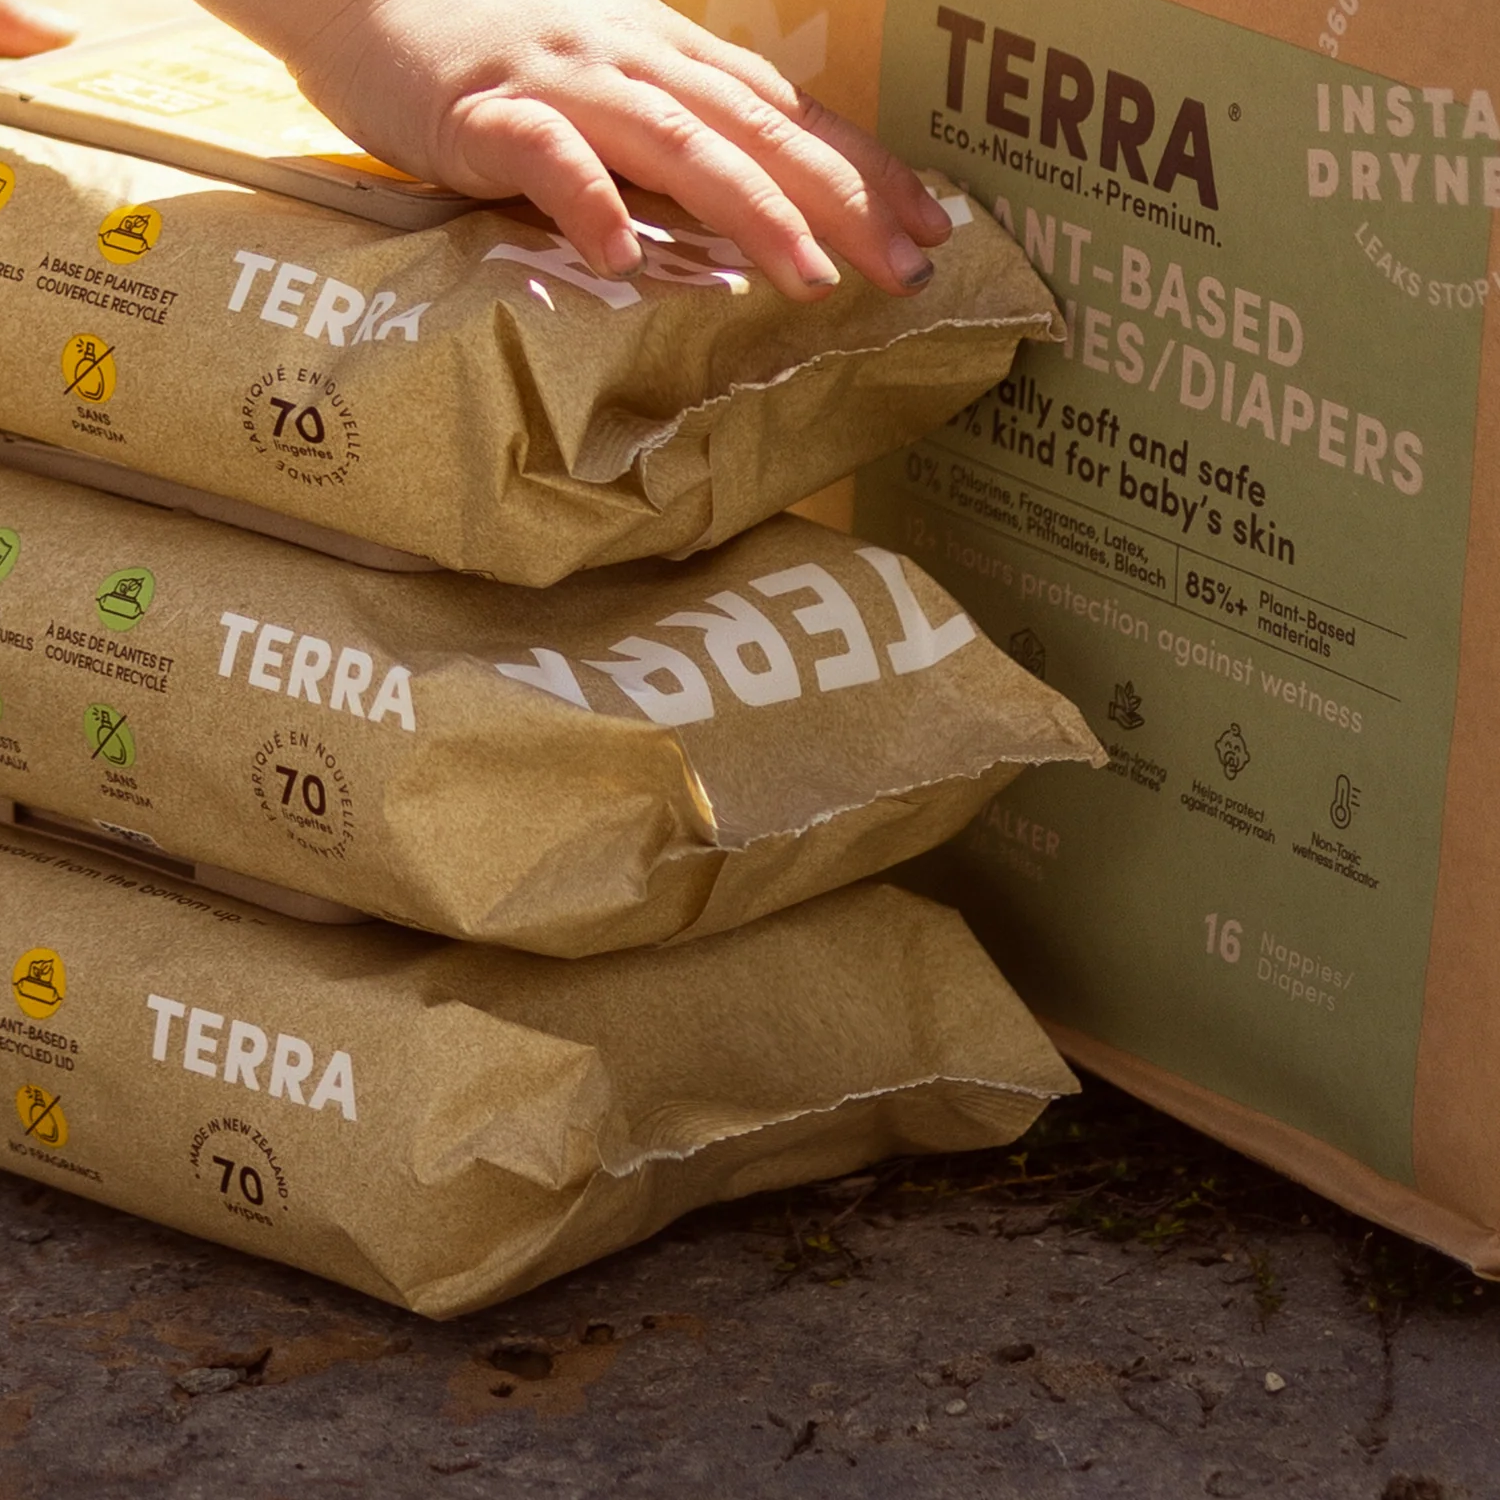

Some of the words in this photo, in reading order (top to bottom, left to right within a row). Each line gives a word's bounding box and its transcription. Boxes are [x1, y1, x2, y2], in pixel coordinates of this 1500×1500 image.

[937, 4, 1219, 212] TERRA
[39, 252, 50, 270] À
[51, 256, 83, 280] BASE
[85, 267, 103, 284] DE
[104, 273, 160, 301] PLANTES
[161, 289, 179, 306] ET
[1354, 220, 1421, 298] LEAKS
[1428, 278, 1489, 310] STOP
[36, 276, 110, 309] COUVERCLE
[112, 298, 169, 325] RECYCLÉ
[227, 249, 433, 347] TERRA
[297, 368, 322, 385] EN
[72, 420, 127, 444] PARFUM
[77, 407, 112, 426] SANS
[270, 397, 325, 444] 70
[273, 439, 334, 461] lingettes
[906, 452, 941, 492] 0%
[1061, 403, 1120, 448] soft
[1129, 432, 1189, 477] and
[1198, 459, 1266, 507] safe
[992, 409, 1056, 468] kind
[1066, 441, 1110, 488] for
[1233, 513, 1295, 565] skin
[950, 489, 1022, 532] Parabens,
[1026, 518, 1110, 568] Phthalates,
[1114, 554, 1166, 589] Bleach
[951, 463, 1014, 509] Chlorine,
[1019, 492, 1099, 543] Fragrance,
[1104, 527, 1149, 564] Latex,
[1185, 571, 1248, 616] 85%+
[1259, 590, 1355, 646] Plant-Based
[45, 620, 56, 638] À
[57, 624, 87, 648] BASE
[89, 635, 105, 653] DE
[107, 641, 157, 670] PLANTES
[158, 656, 174, 673] ET
[947, 530, 1013, 585] hours
[1020, 572, 1150, 643] protection
[1158, 627, 1253, 685] against
[1261, 670, 1363, 733] wetness
[1258, 616, 1331, 658] materials
[45, 645, 114, 677] COUVERCLE
[115, 667, 168, 694] RECYCLÉ
[218, 611, 416, 733] TERRA
[290, 731, 309, 748] EN
[100, 784, 154, 809] PARFUM
[105, 770, 138, 790] SANS
[275, 764, 326, 816] 70
[1192, 779, 1223, 806] Helps
[1225, 795, 1265, 824] protect
[282, 808, 333, 835] lingettes
[1180, 792, 1220, 820] against
[1219, 811, 1252, 836] nappy
[1253, 823, 1276, 845] rash
[1292, 841, 1333, 871] wetness
[1334, 858, 1380, 889] indicator
[1312, 831, 1361, 867] Non-Toxic
[54, 857, 101, 879] from
[104, 873, 138, 891] the
[140, 883, 208, 913] bottom
[213, 908, 243, 925] up.
[1204, 912, 1243, 964] 16
[1261, 931, 1356, 990] Nappies/
[1256, 959, 1336, 1013] Diapers
[55, 1053, 75, 1072] LID
[70, 1039, 79, 1054] &
[147, 993, 358, 1122] TERRA
[190, 1127, 209, 1167] MADE
[208, 1119, 221, 1134] IN
[223, 1117, 252, 1136] NEW
[252, 1130, 289, 1199] ZEALAND
[212, 1155, 264, 1206] 70
[223, 1201, 274, 1227] wipes
